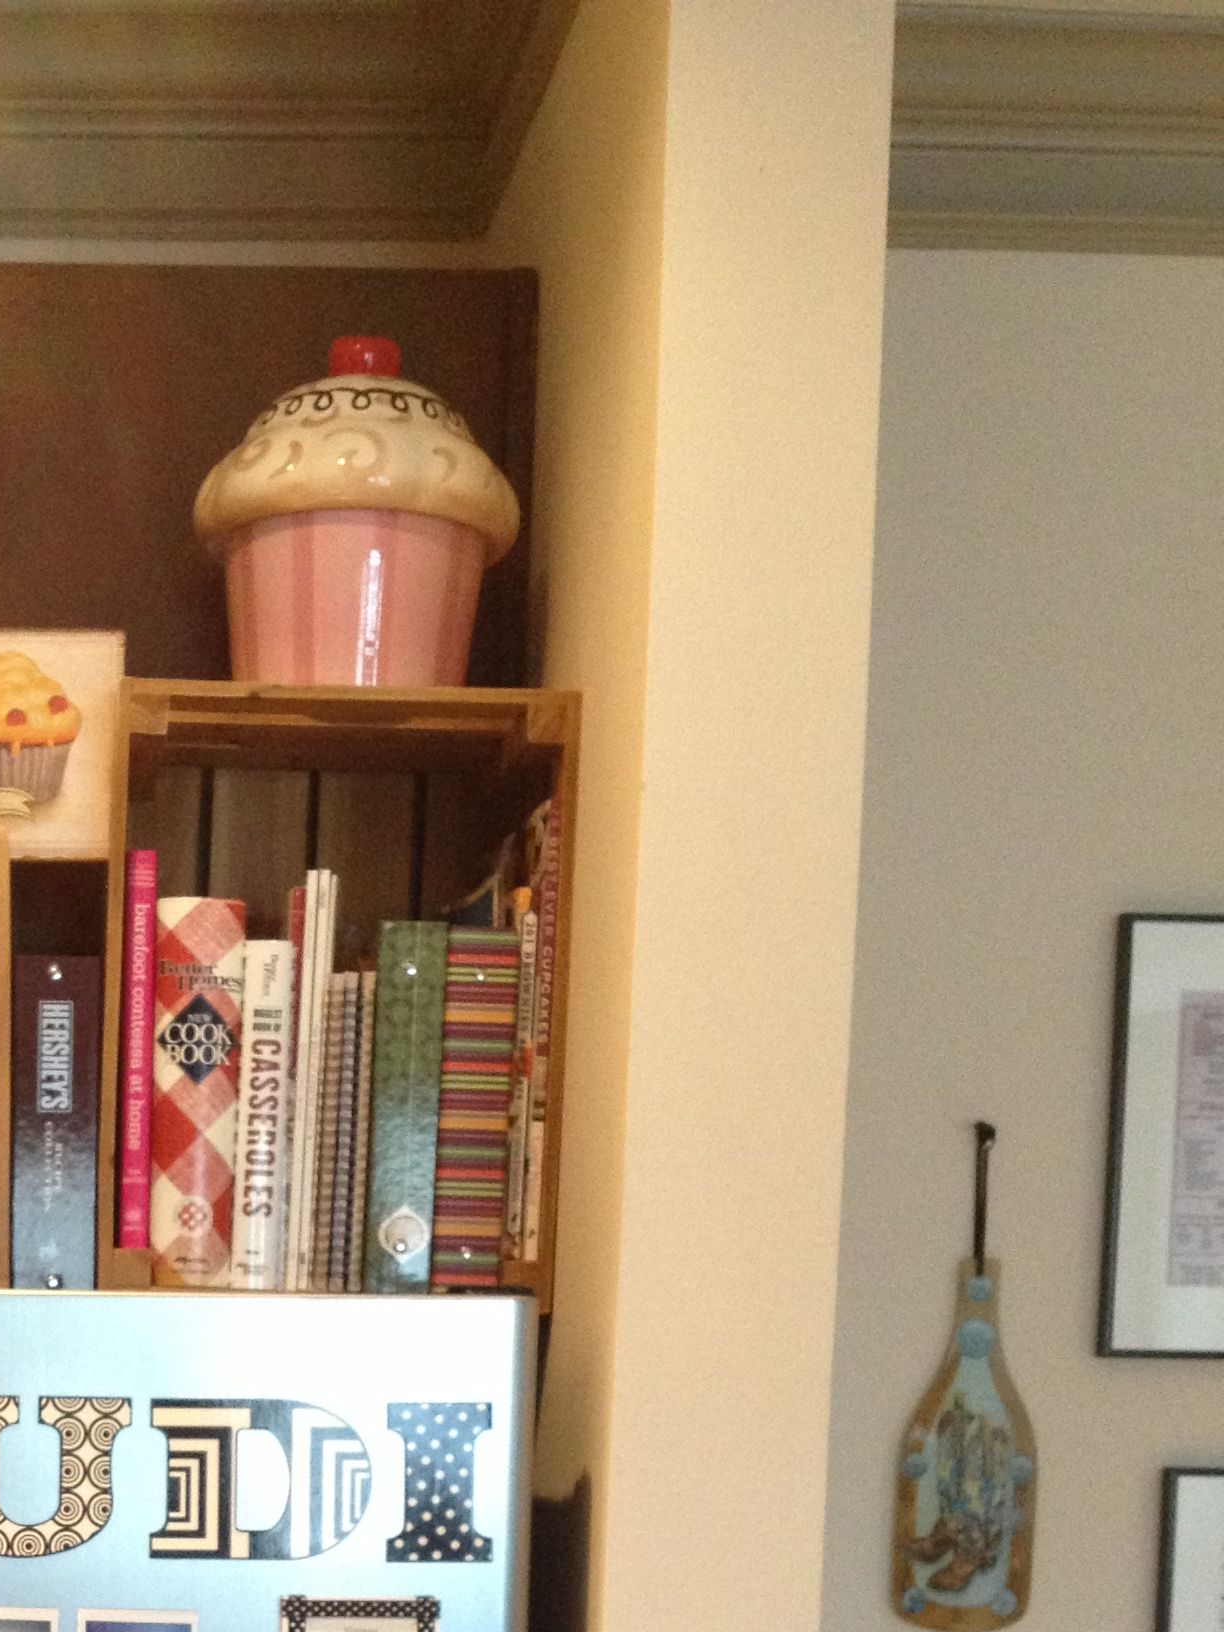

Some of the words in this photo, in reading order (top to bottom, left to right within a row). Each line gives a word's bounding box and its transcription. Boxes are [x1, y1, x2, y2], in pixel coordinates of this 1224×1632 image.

[132, 902, 151, 982] barefoot
[129, 987, 146, 1069] contessa
[166, 1022, 233, 1045] COOK
[538, 946, 554, 1043] CUPCAKES
[39, 1002, 71, 1111] HERSHEY'S
[128, 1075, 144, 1094] at
[167, 1043, 230, 1066] BOOK
[127, 1098, 146, 1151] home
[241, 1038, 282, 1218] CASSEROLES
